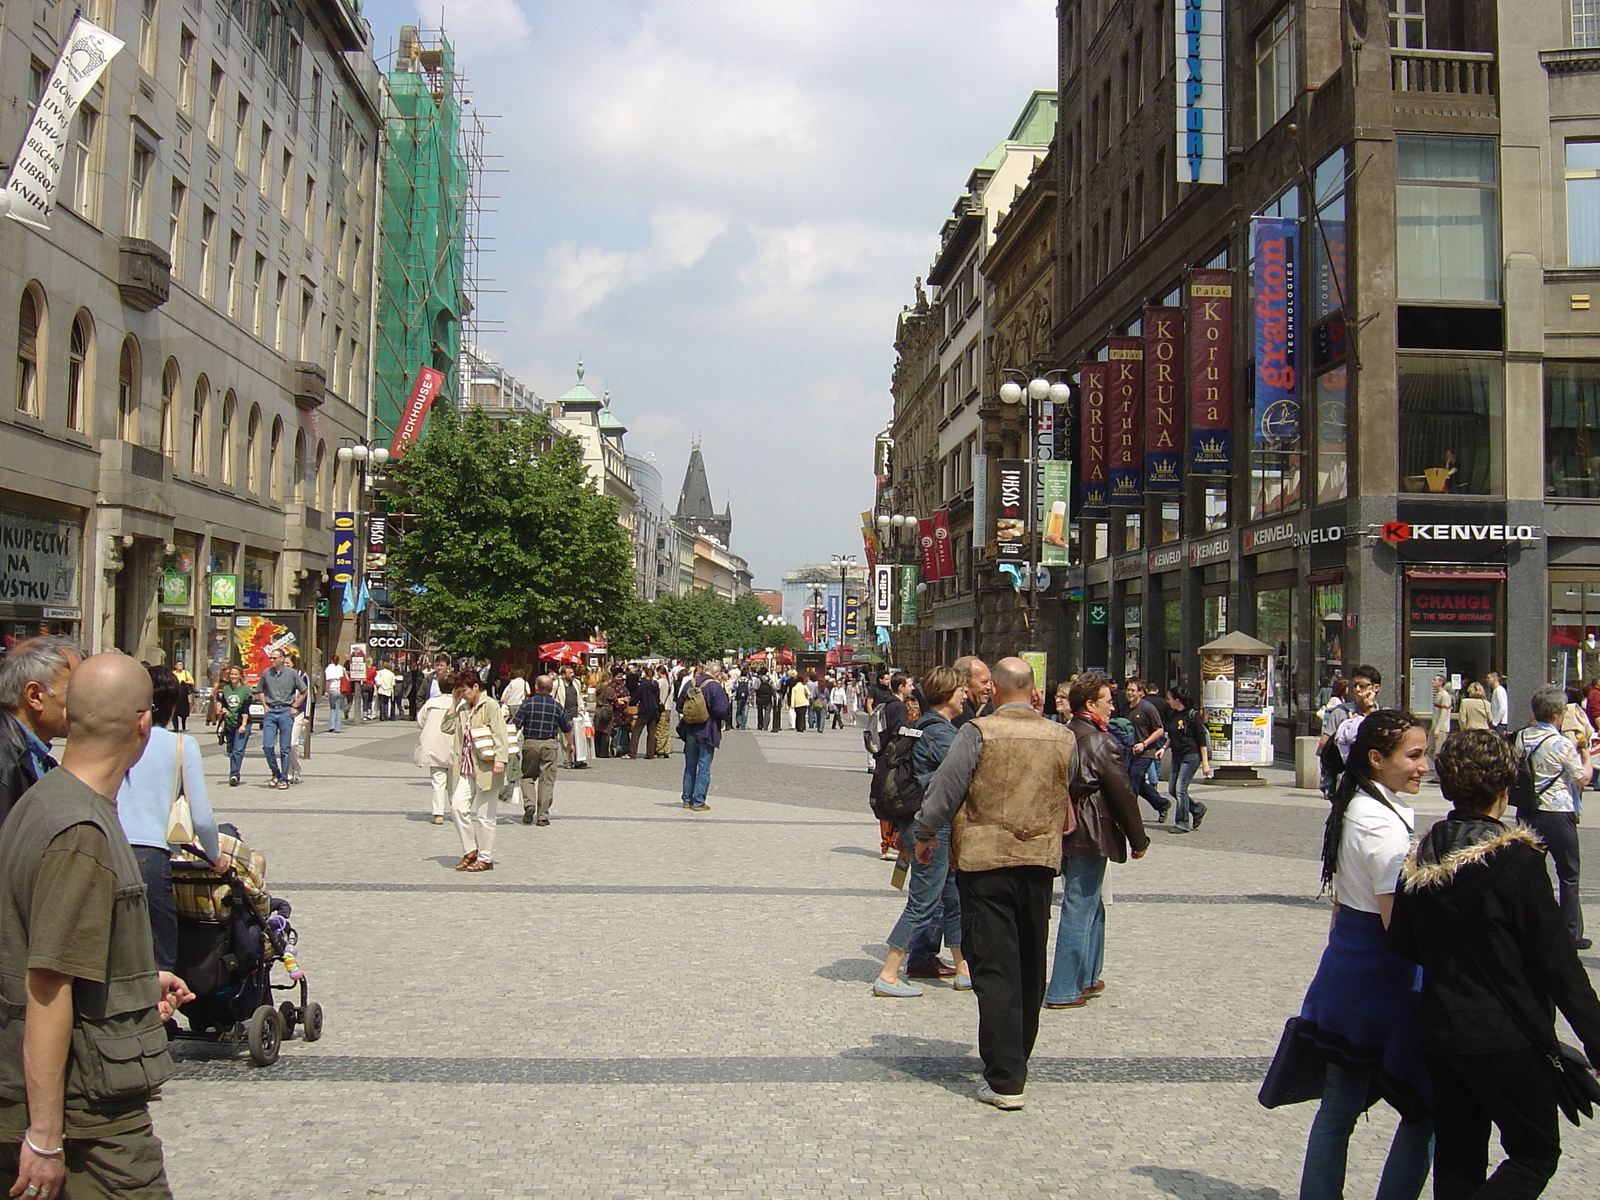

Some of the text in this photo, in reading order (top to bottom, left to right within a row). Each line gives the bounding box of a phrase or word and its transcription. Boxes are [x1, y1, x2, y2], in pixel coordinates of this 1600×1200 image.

[19, 157, 56, 193] LIBROS
[10, 178, 53, 216] KNIHY
[1195, 286, 1228, 296] Palác
[1256, 237, 1295, 389] grafton
[1204, 302, 1222, 420] Koruna
[1156, 321, 1174, 447] KORUNA
[1120, 364, 1134, 462] Koruna
[1088, 373, 1104, 480] KORUNA
[1002, 475, 1020, 507] SUSHI
[371, 521, 385, 545] SUSHI
[1253, 523, 1294, 546] KENVELO
[1412, 525, 1531, 540] KENVELO
[1154, 550, 1181, 568] KENVELO
[1197, 539, 1229, 559] KENVELO
[8, 554, 30, 573] NA
[1416, 594, 1490, 609] CHANGE
[1458, 613, 1493, 621] ENTRANCE
[263, 631, 297, 655] Khamoro
[370, 637, 404, 648] ecco
